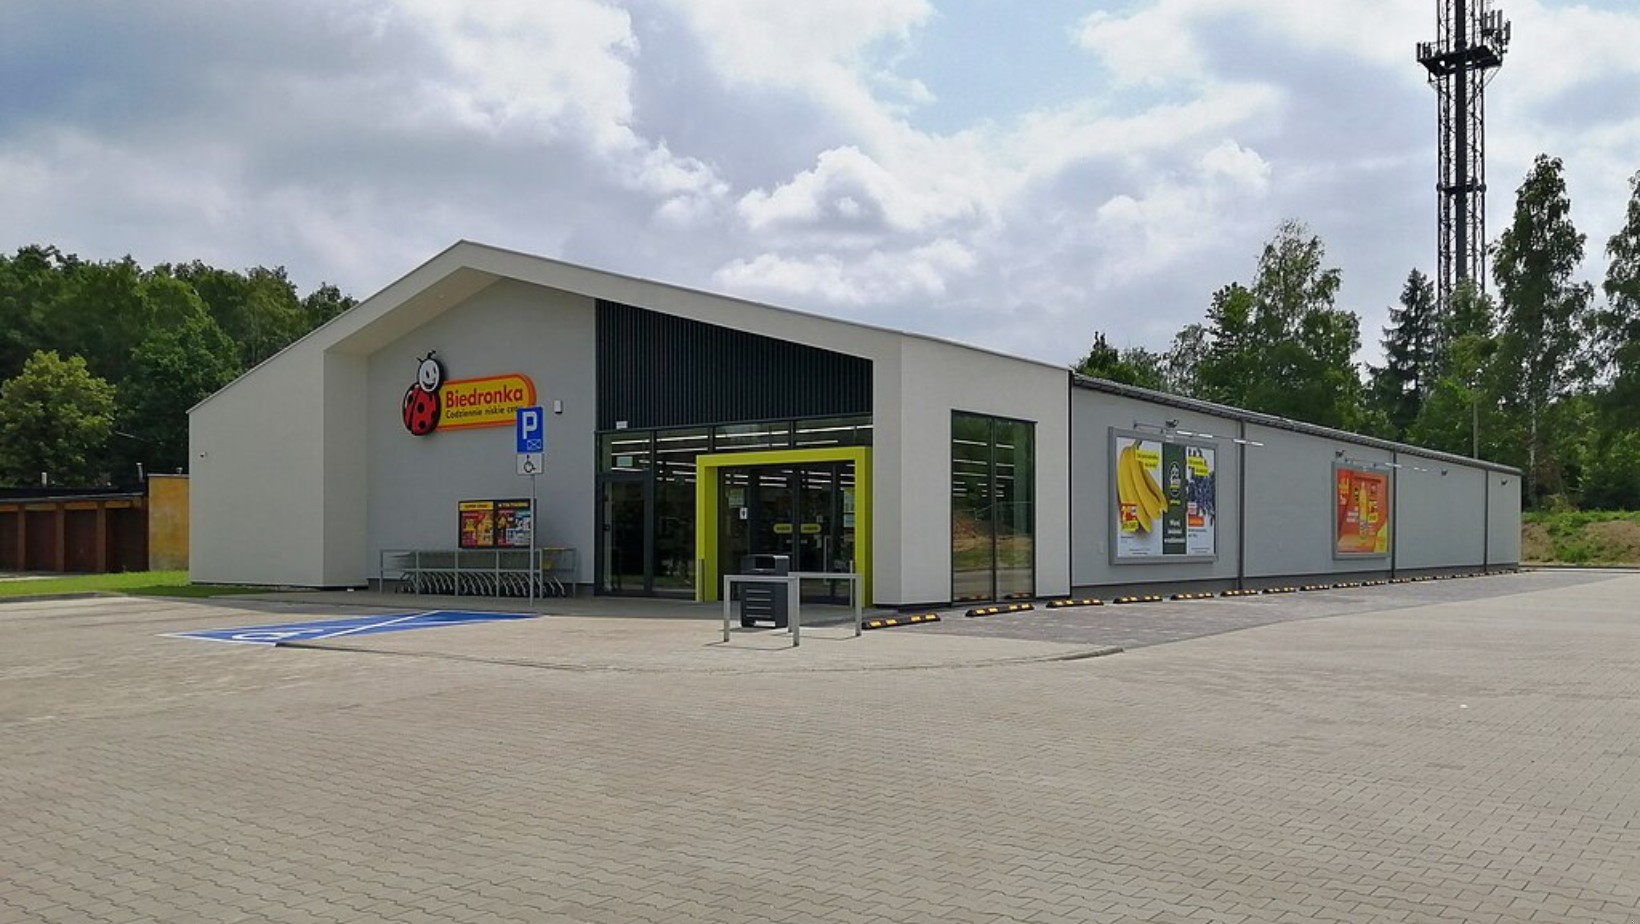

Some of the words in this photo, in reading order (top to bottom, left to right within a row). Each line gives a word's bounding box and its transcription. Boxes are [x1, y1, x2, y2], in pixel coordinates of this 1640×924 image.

[446, 384, 523, 408] Biedronka
[445, 408, 483, 419] Codziennie
[485, 405, 505, 415] niskie
[522, 411, 538, 440] P
